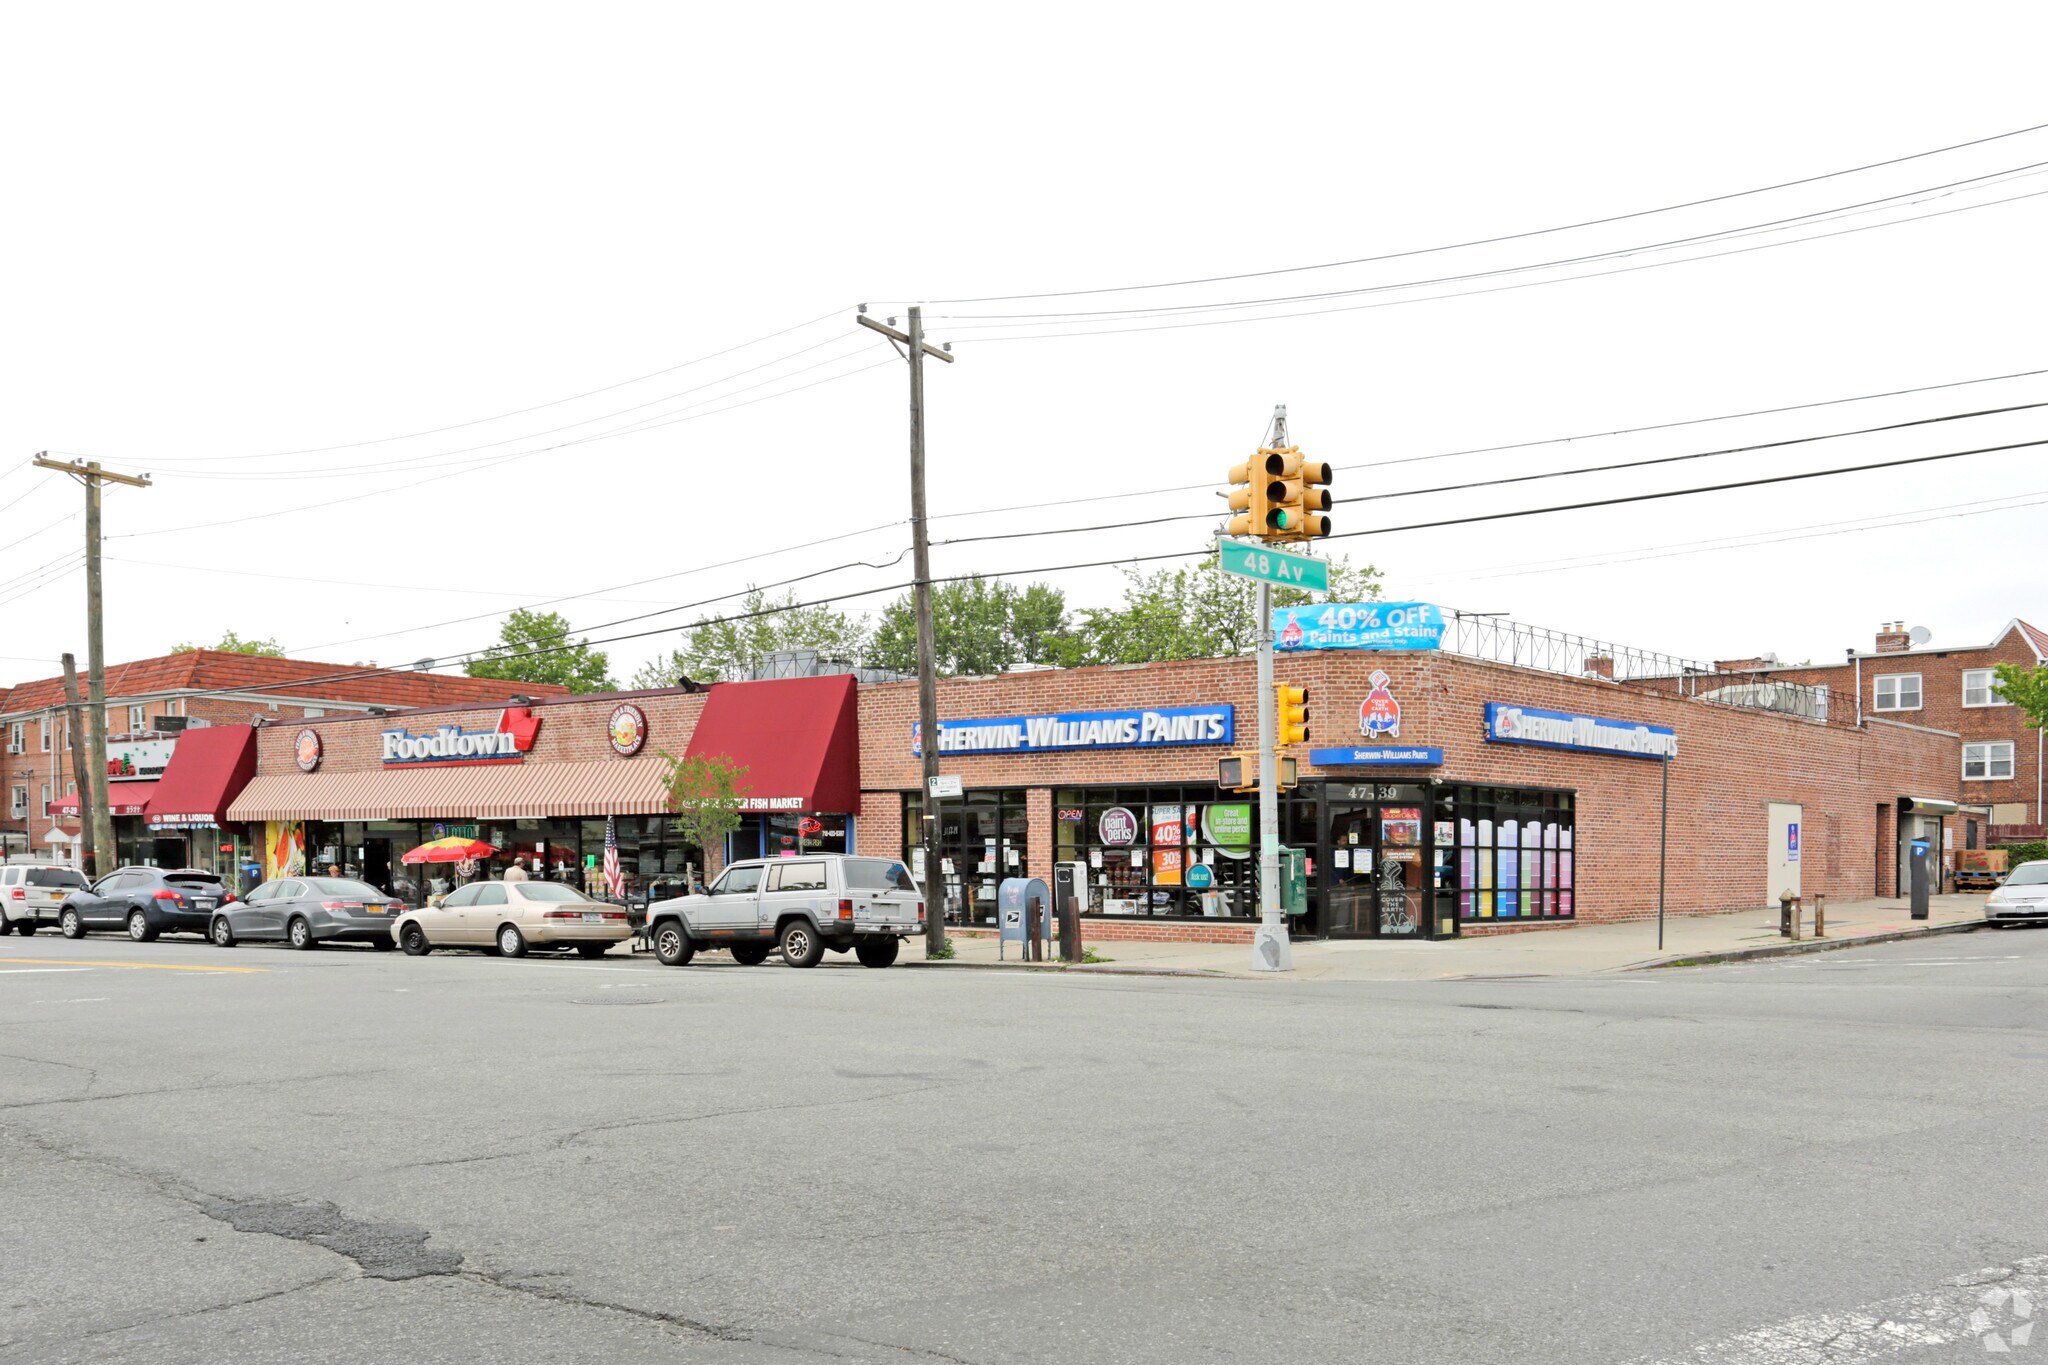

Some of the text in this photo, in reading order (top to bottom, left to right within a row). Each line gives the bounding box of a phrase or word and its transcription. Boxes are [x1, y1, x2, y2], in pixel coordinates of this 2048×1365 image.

[1244, 552, 1303, 581] 48 Av
[1318, 605, 1431, 630] 40% OFF
[1309, 630, 1357, 643] Paints
[1361, 627, 1391, 639] and
[1394, 625, 1439, 639] Stains
[1138, 712, 1226, 743] PAINTS
[1509, 708, 1678, 757] SHERWIN-WILLIAMS PAINTS
[382, 728, 517, 760] Foodtown
[1353, 750, 1412, 760] SHERWIN-WILLIAMS
[750, 797, 769, 809] FISH
[769, 797, 803, 809] MARKET
[163, 812, 214, 823] WINE & LIQUOR
[1058, 809, 1083, 820] OPEN
[1224, 809, 1239, 817] Great
[1104, 816, 1127, 831] paint
[1215, 817, 1248, 825] in-store and
[1107, 828, 1132, 842] perks
[1155, 824, 1181, 843] 40%
[1231, 826, 1248, 834] perks
[1162, 850, 1181, 866] 30%
[1916, 847, 1923, 856] P
[252, 869, 258, 877] P
